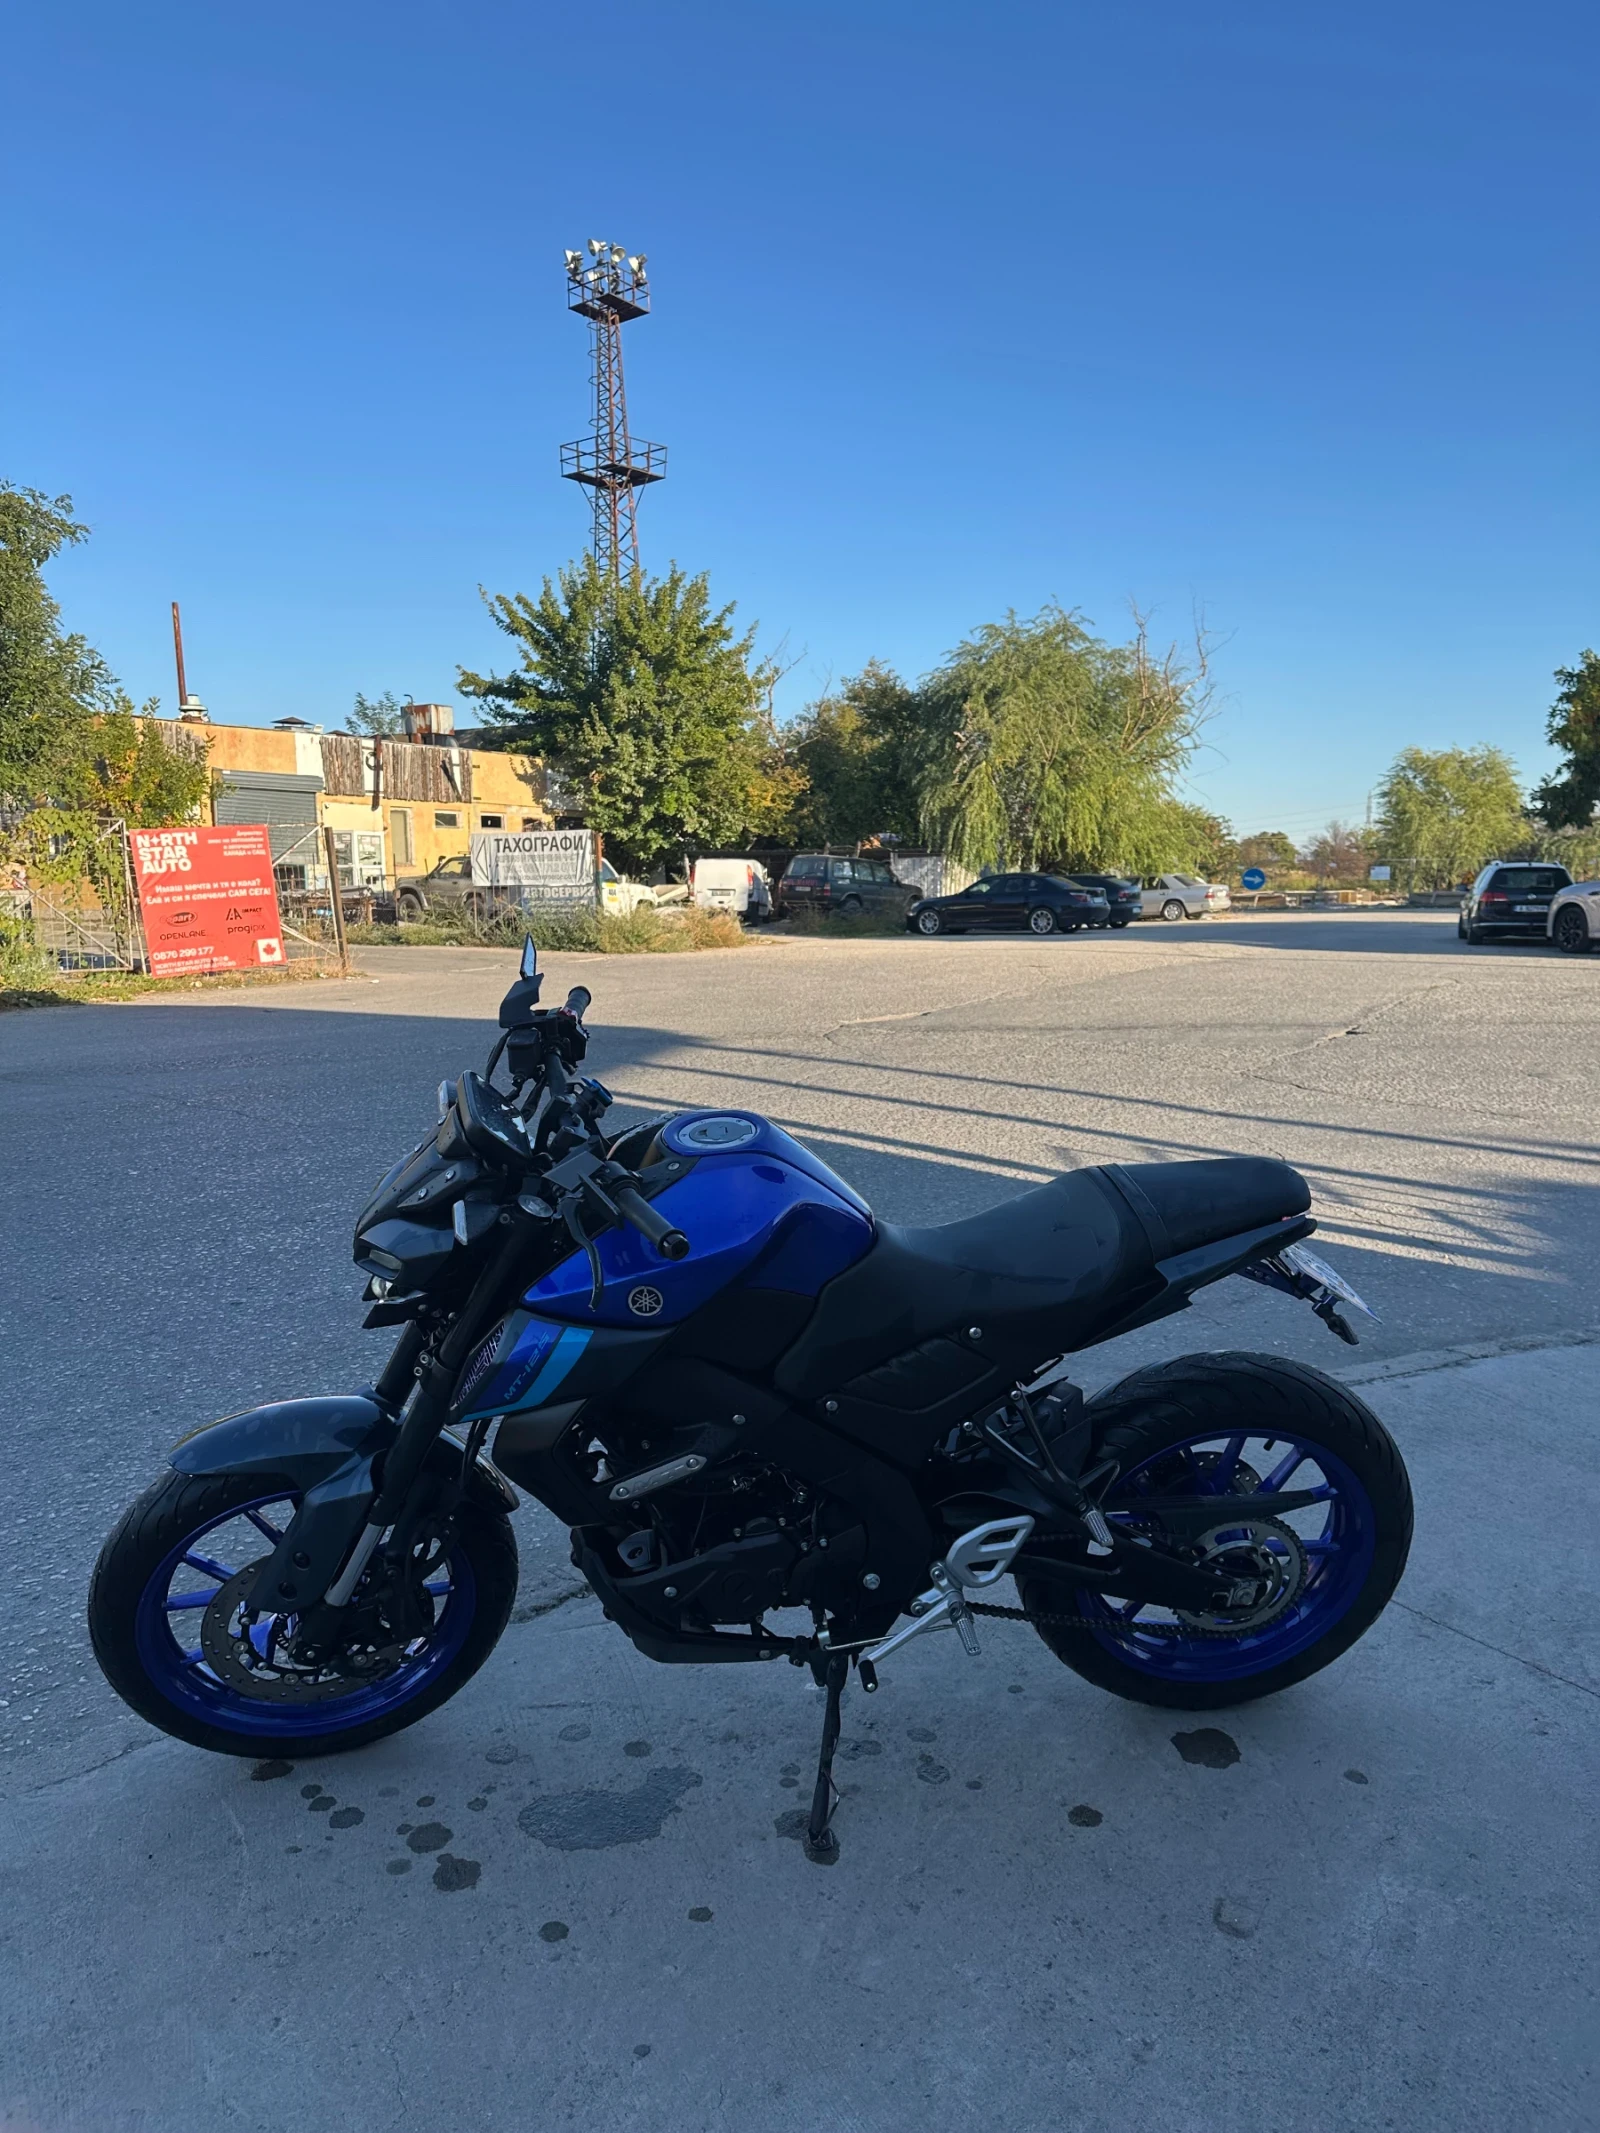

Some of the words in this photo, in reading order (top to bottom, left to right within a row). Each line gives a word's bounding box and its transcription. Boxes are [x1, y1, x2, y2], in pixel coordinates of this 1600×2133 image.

[494, 835, 585, 853] ТАХОГРАФИ
[138, 845, 188, 861] STAR
[142, 858, 192, 874] AUTO
[155, 884, 183, 893] Имаш
[184, 882, 212, 891] мечта
[237, 878, 261, 887] кола?
[146, 895, 162, 905] Ела
[192, 892, 227, 901] спечели
[228, 889, 247, 898] САМ
[248, 887, 272, 896] СЕГА!
[159, 930, 206, 941] OPENLANE
[198, 946, 215, 955] 177
[503, 1331, 551, 1400] MT-125
